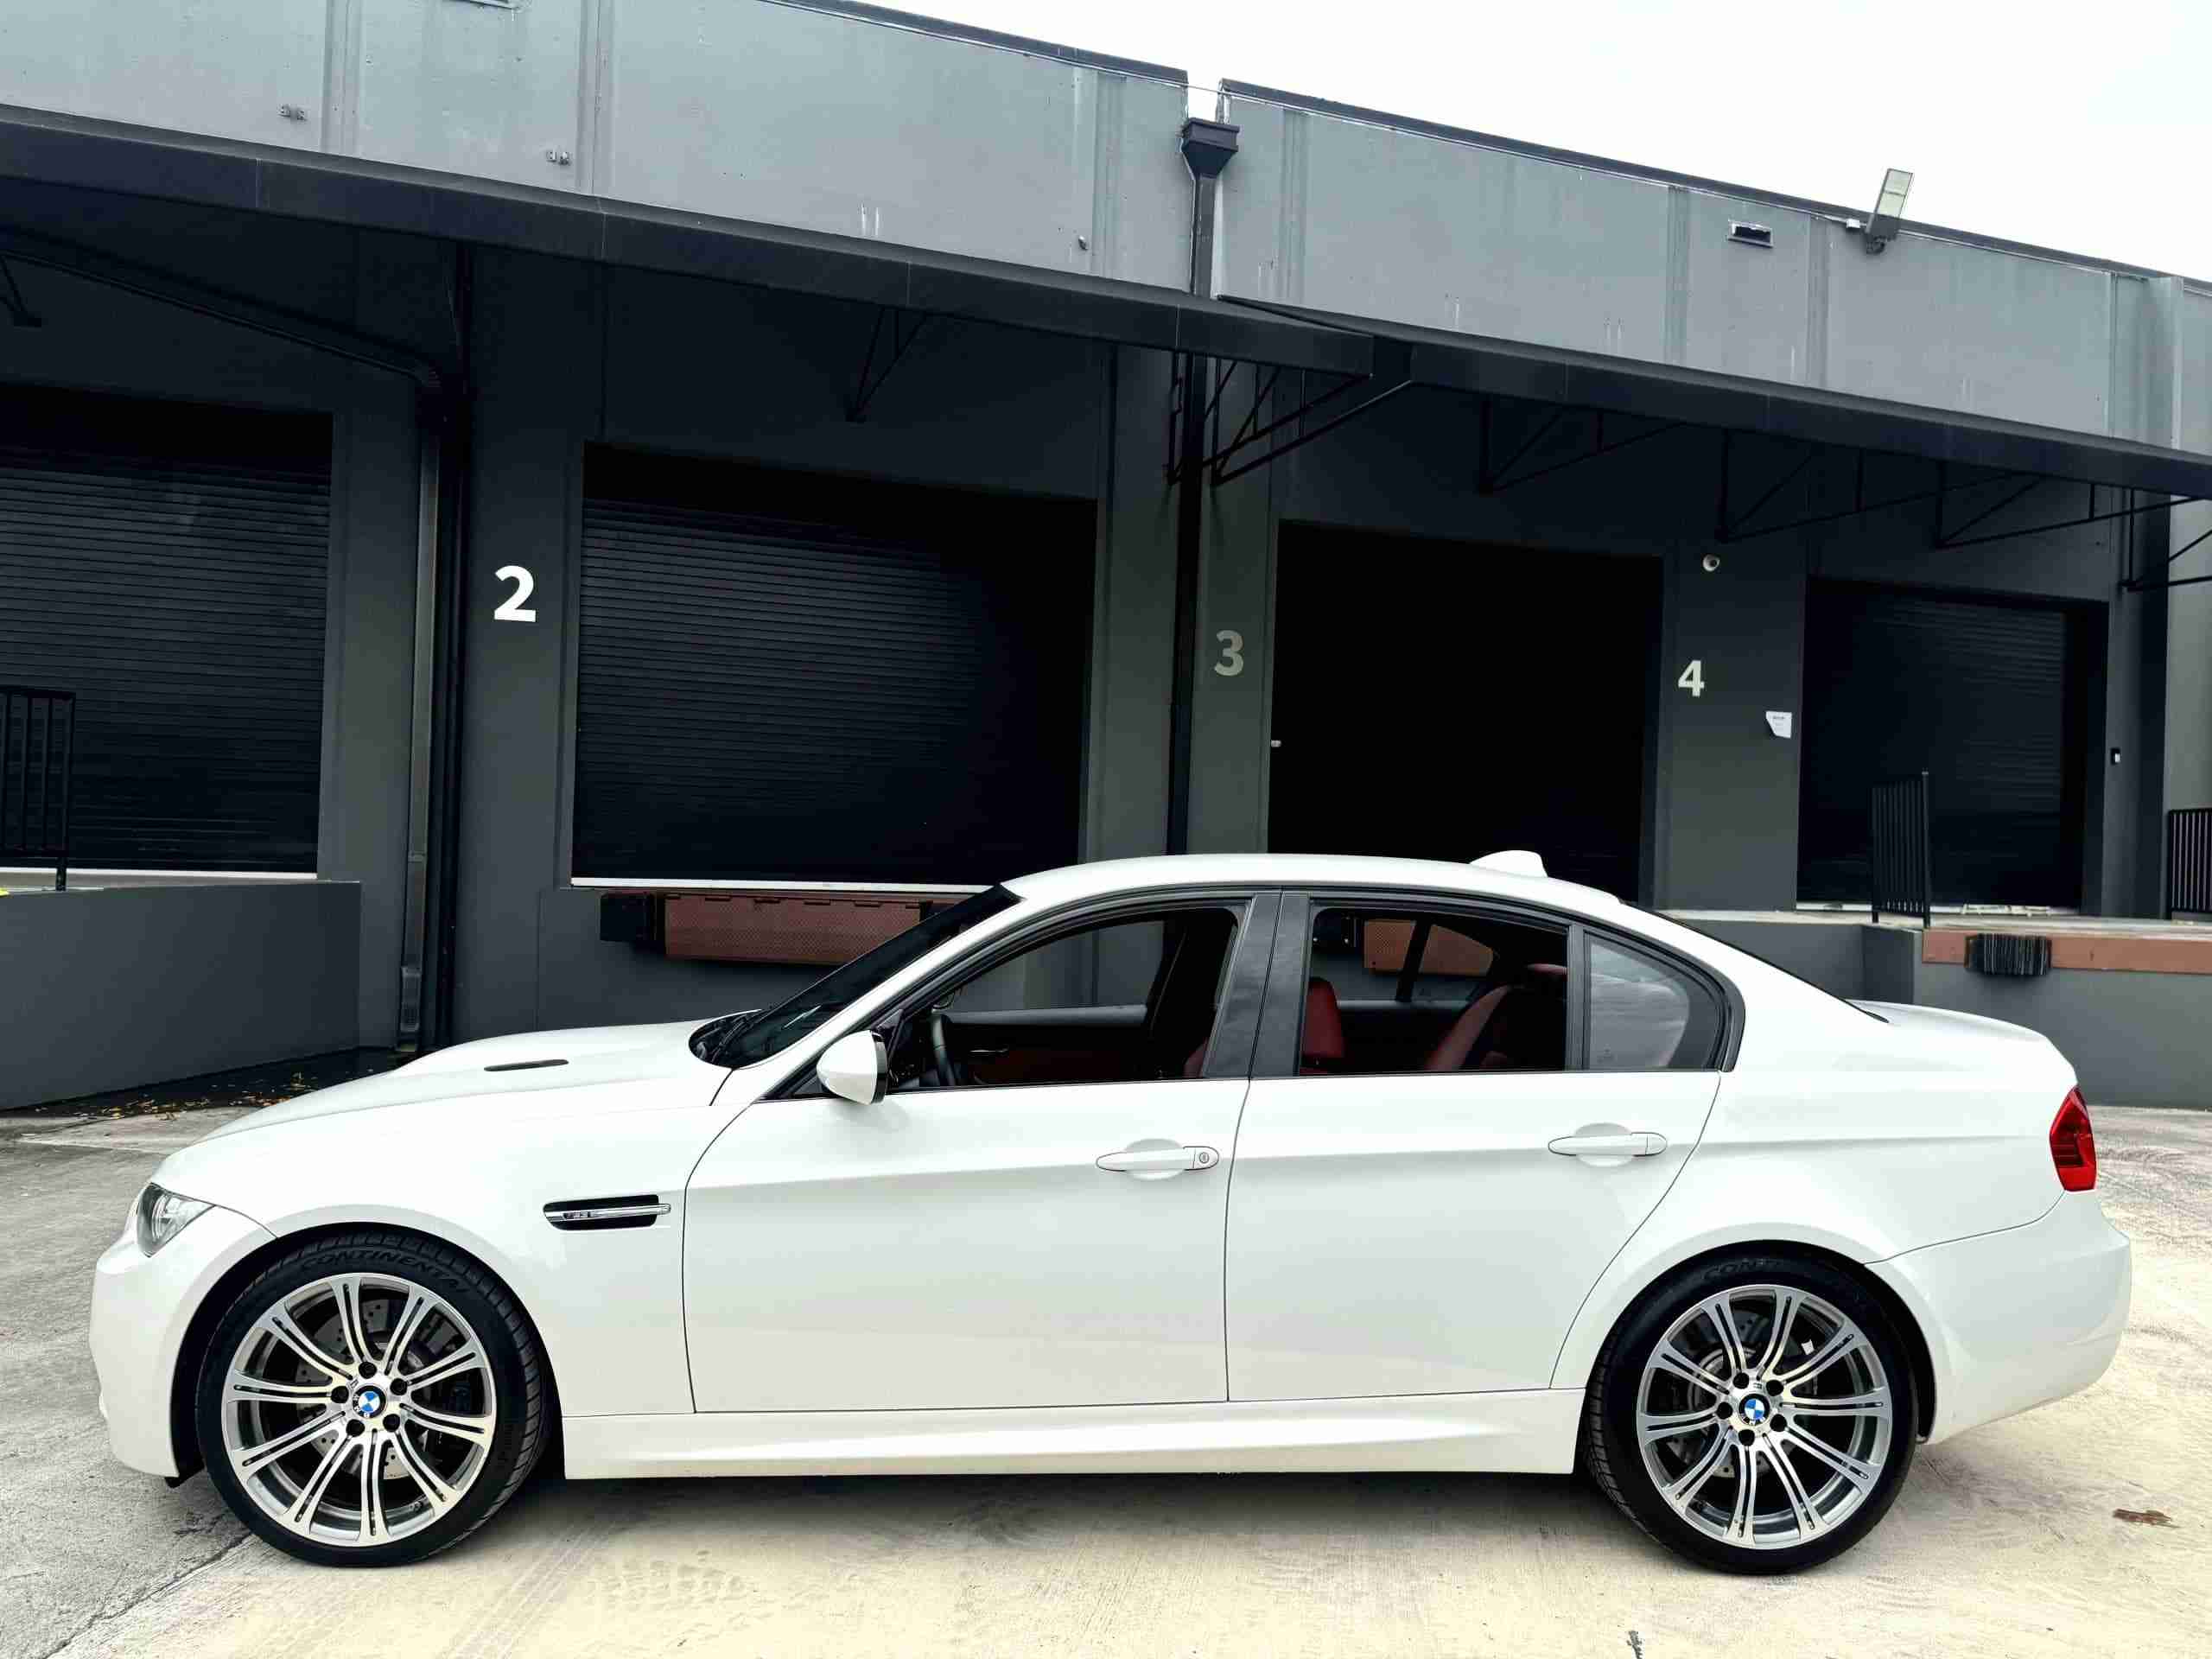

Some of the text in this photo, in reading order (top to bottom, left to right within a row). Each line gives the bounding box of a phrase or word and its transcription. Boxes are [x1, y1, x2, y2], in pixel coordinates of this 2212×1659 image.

[493, 565, 537, 623] 2
[1214, 630, 1244, 677] 3
[1678, 660, 1705, 697] 4
